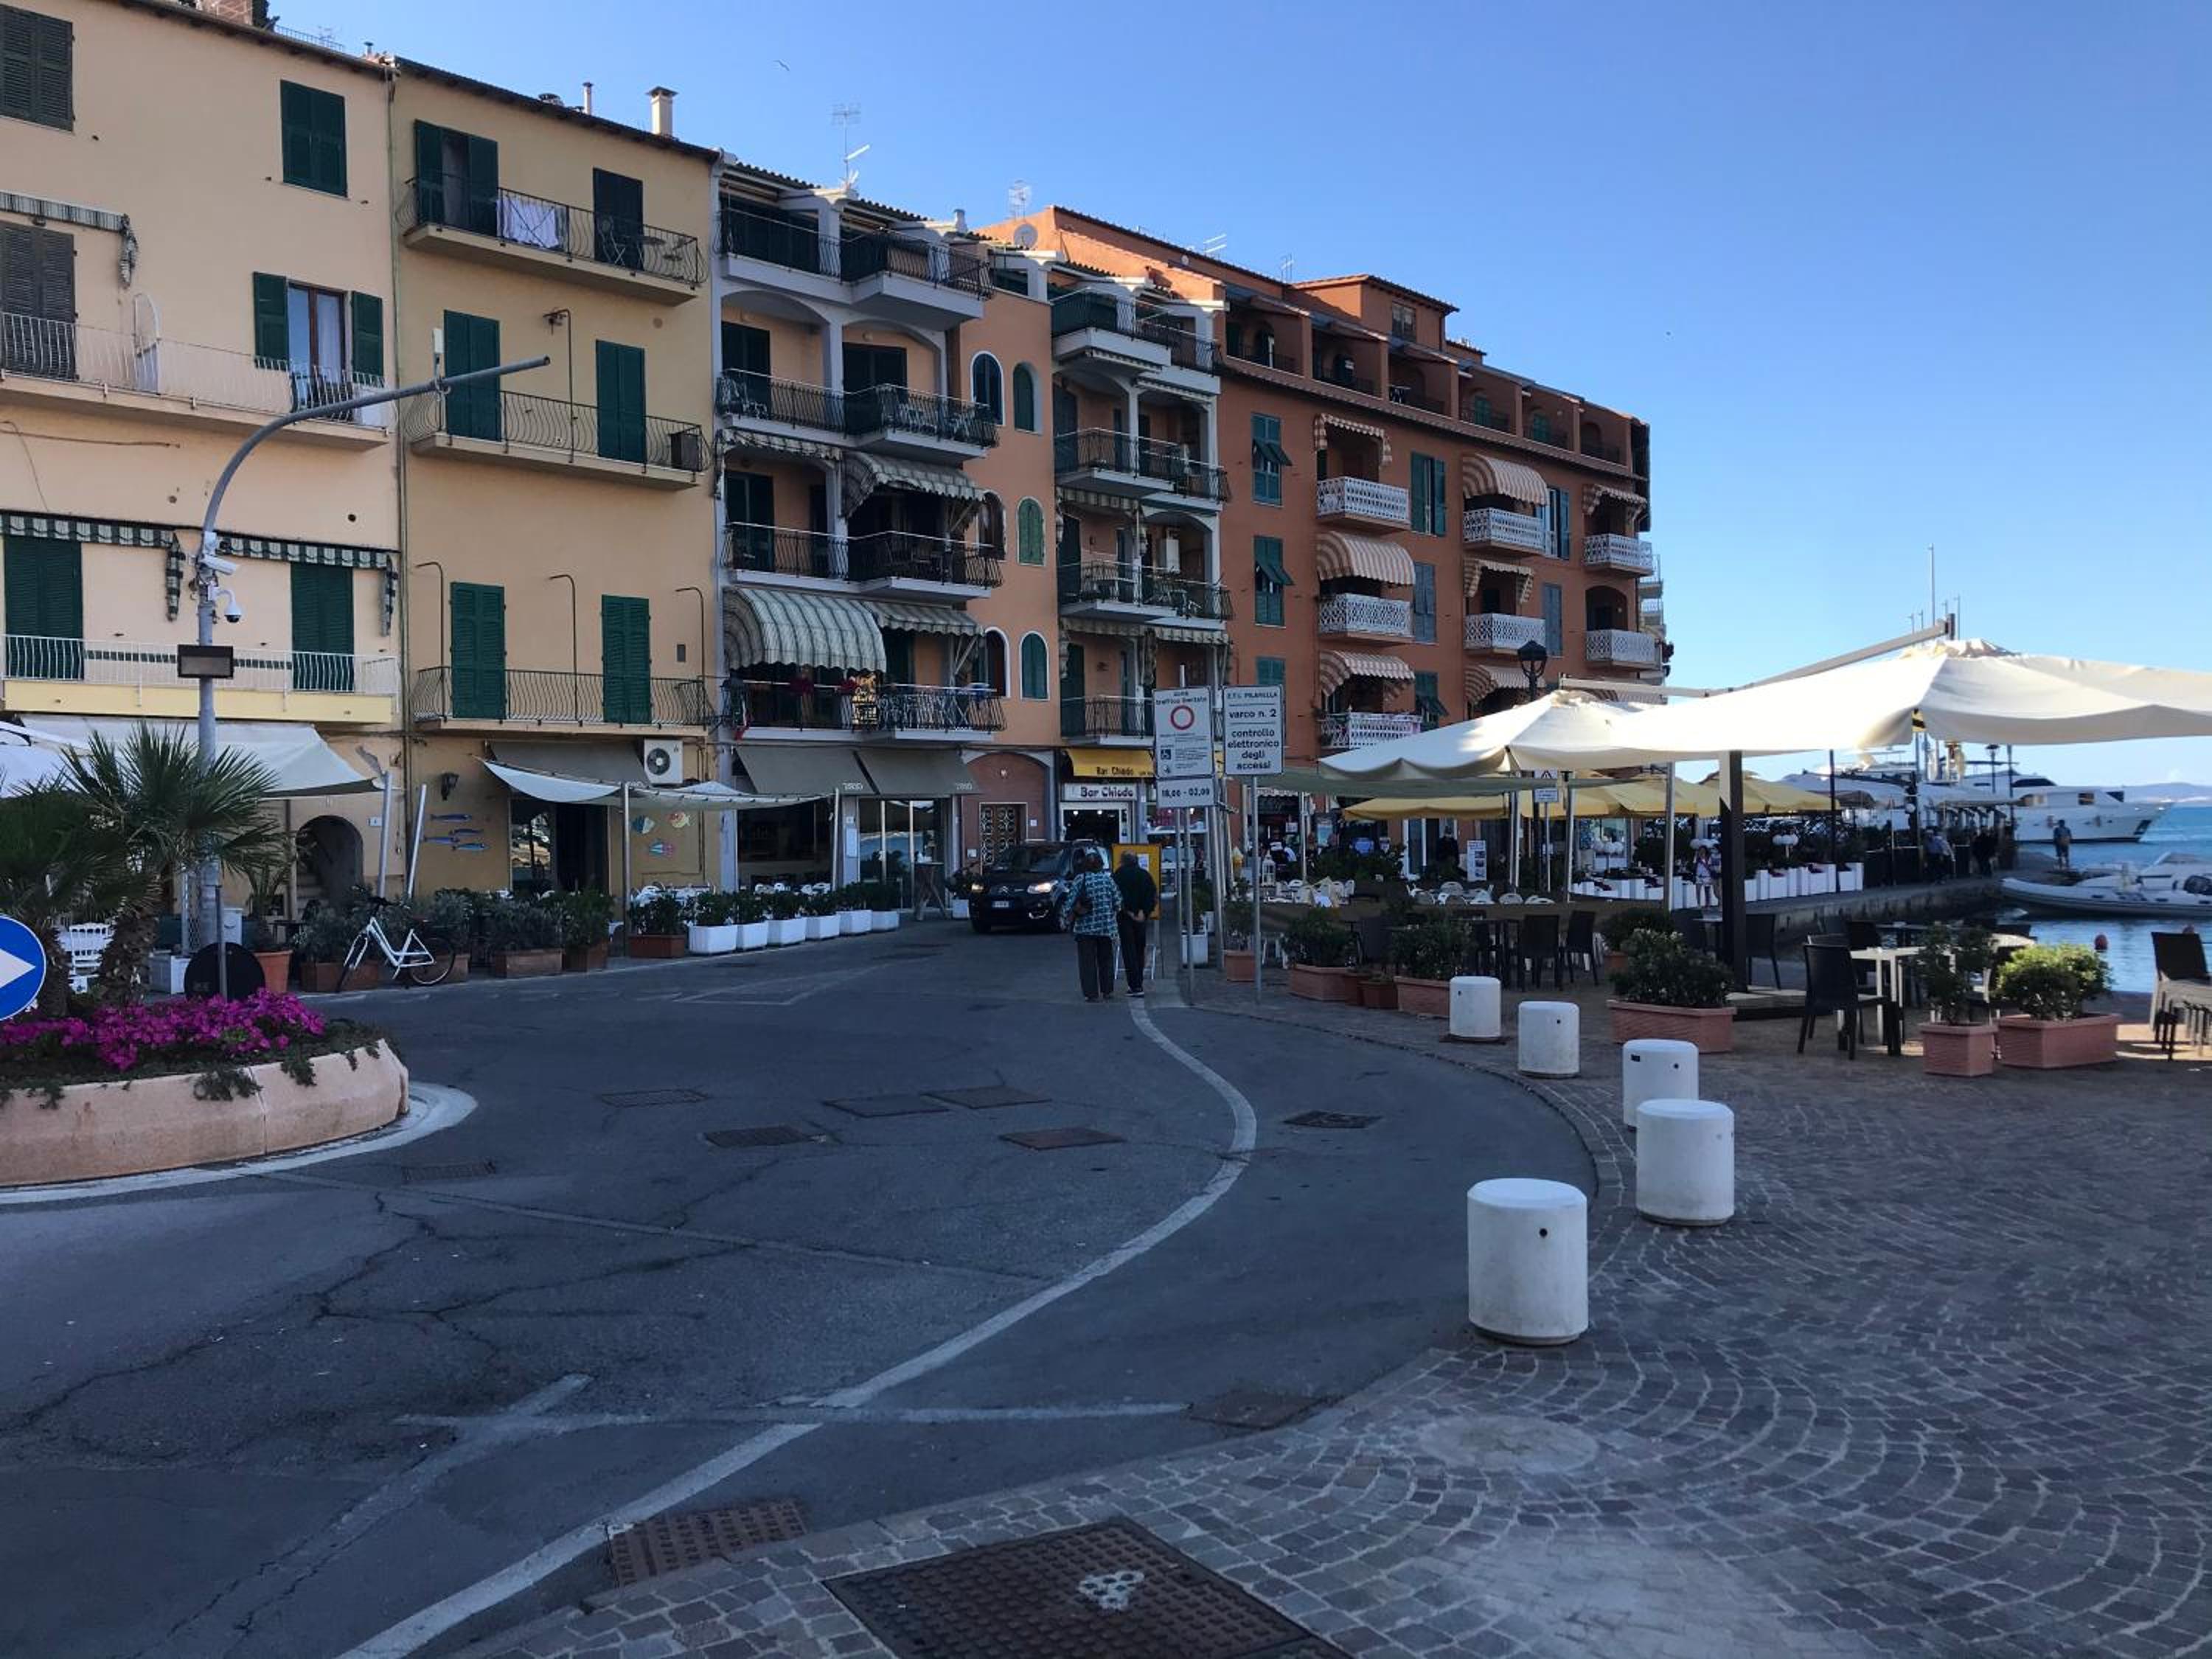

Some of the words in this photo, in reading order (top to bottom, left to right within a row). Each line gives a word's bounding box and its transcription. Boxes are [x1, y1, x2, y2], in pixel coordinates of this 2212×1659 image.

[1228, 710, 1256, 718] varco
[1269, 709, 1276, 717] 2
[1231, 728, 1275, 737] controllo
[1227, 740, 1279, 748] elettronico
[1241, 750, 1265, 759] degli
[1237, 760, 1271, 770] accessi
[1080, 786, 1099, 797] Bar
